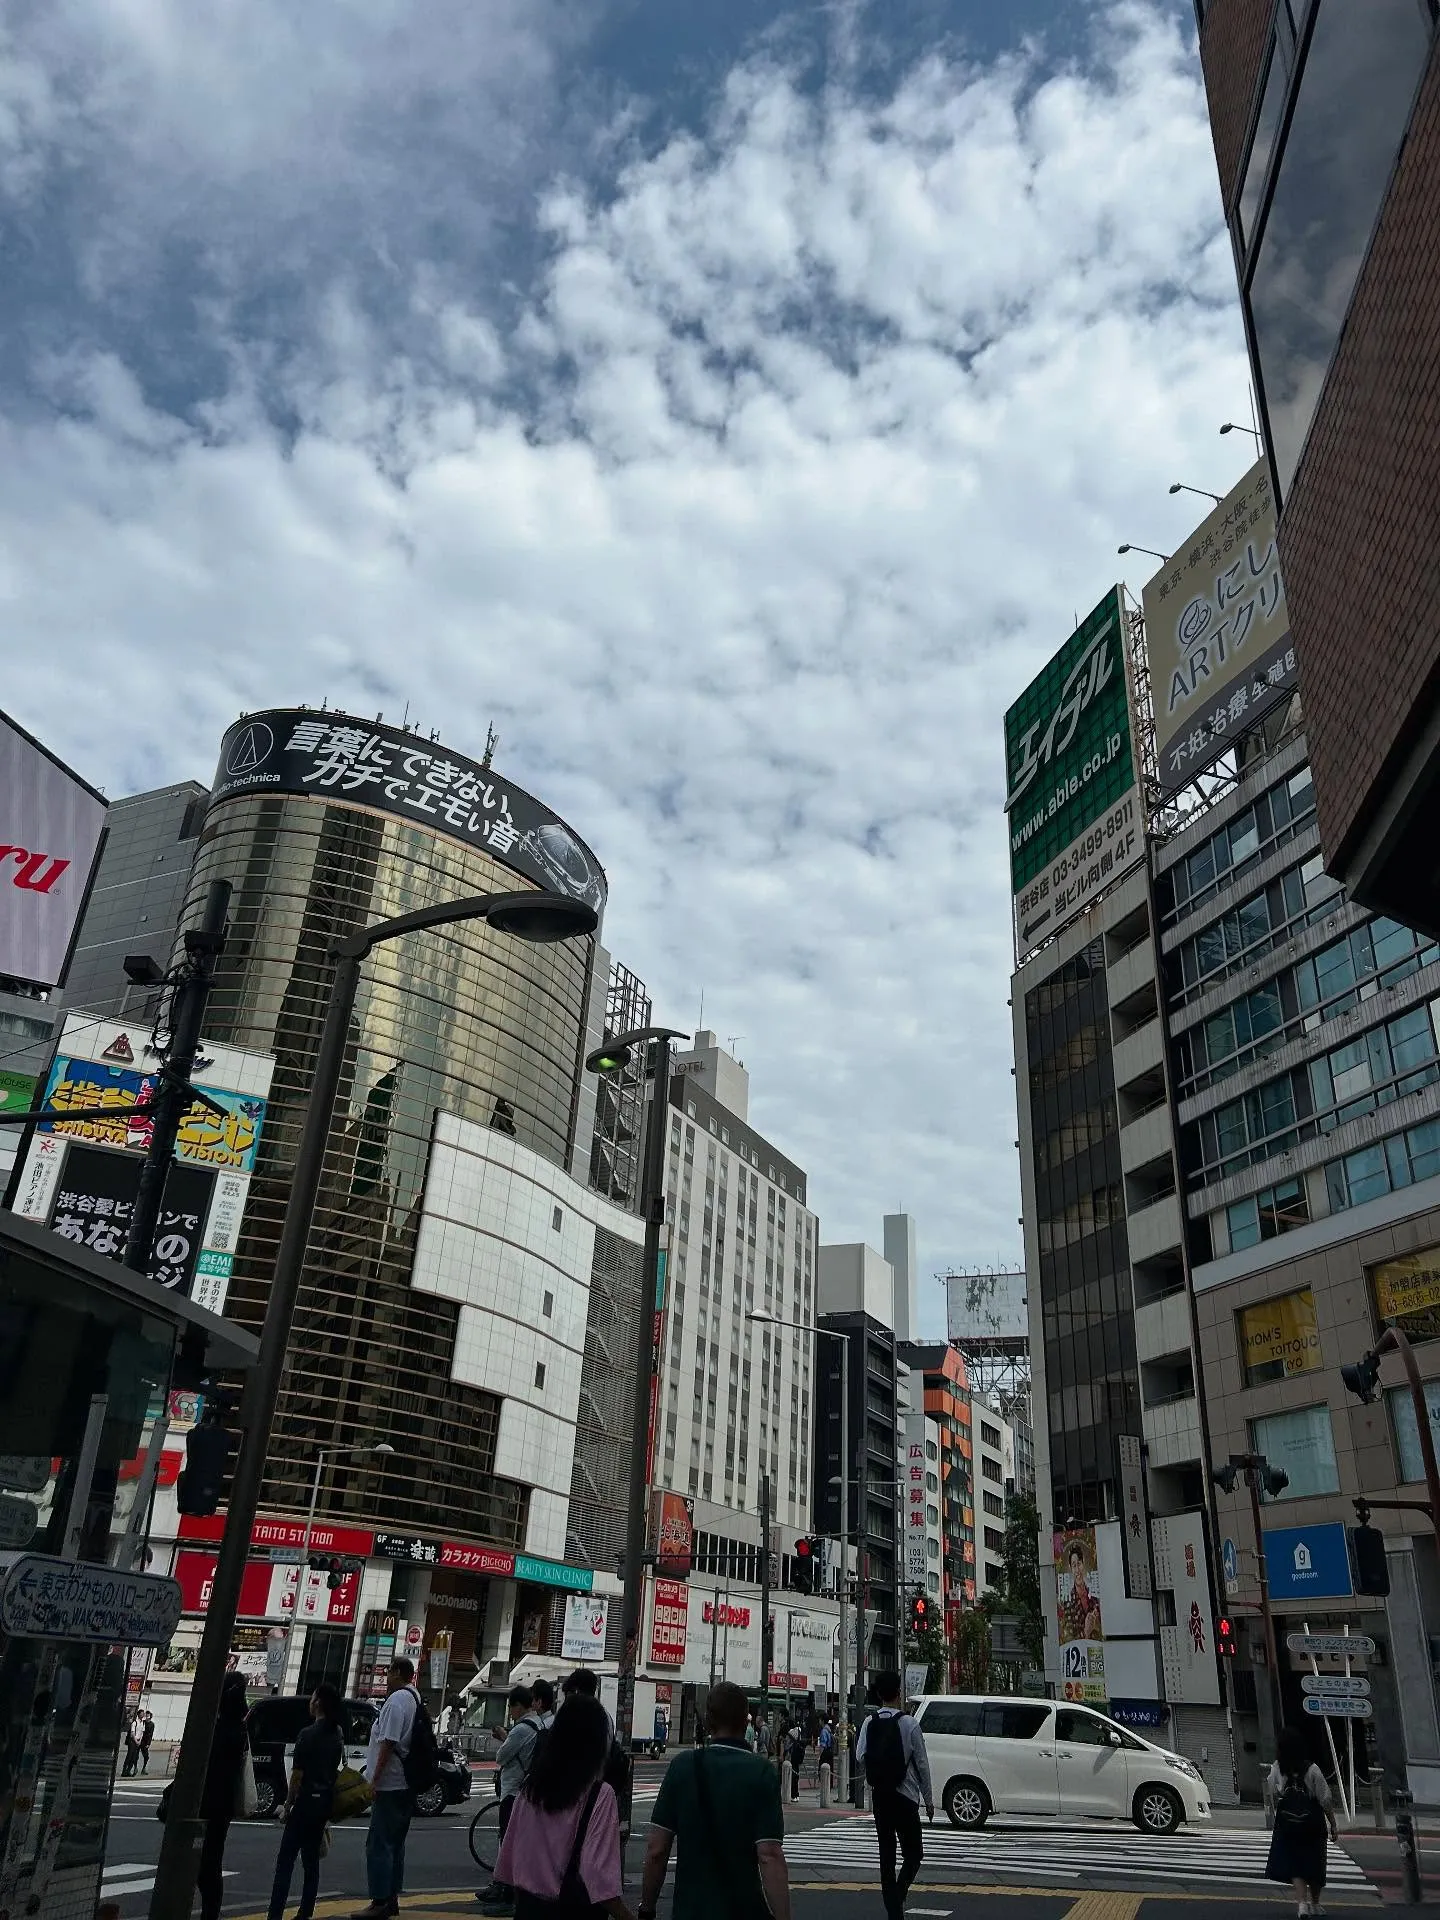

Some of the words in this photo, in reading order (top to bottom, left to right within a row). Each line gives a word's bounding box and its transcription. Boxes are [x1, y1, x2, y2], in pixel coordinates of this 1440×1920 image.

[1003, 615, 1114, 814] エイブル
[284, 720, 514, 822] 言葉にできない、
[302, 755, 520, 855] ガチでエモい音
[1011, 733, 1122, 853] www.able.co.jp
[1019, 874, 1051, 917] 渋谷店
[1052, 798, 1134, 888] 03-3499-8911
[1054, 848, 1114, 917] 当ビル向側
[1115, 828, 1136, 863] 4F
[180, 1143, 243, 1167] VISION
[210, 1253, 232, 1267] EMI
[909, 1443, 924, 1527] 広告募集
[254, 1525, 286, 1541] TAITO
[442, 1547, 481, 1567] カラオケ
[909, 1557, 925, 1566] 5774
[516, 1559, 543, 1576] BEAUTY
[544, 1564, 561, 1580] SKIN
[562, 1569, 591, 1587] CLINIC
[909, 1566, 926, 1575] 7506
[1291, 1571, 1319, 1583] goodroom
[332, 1604, 351, 1616] B1F
